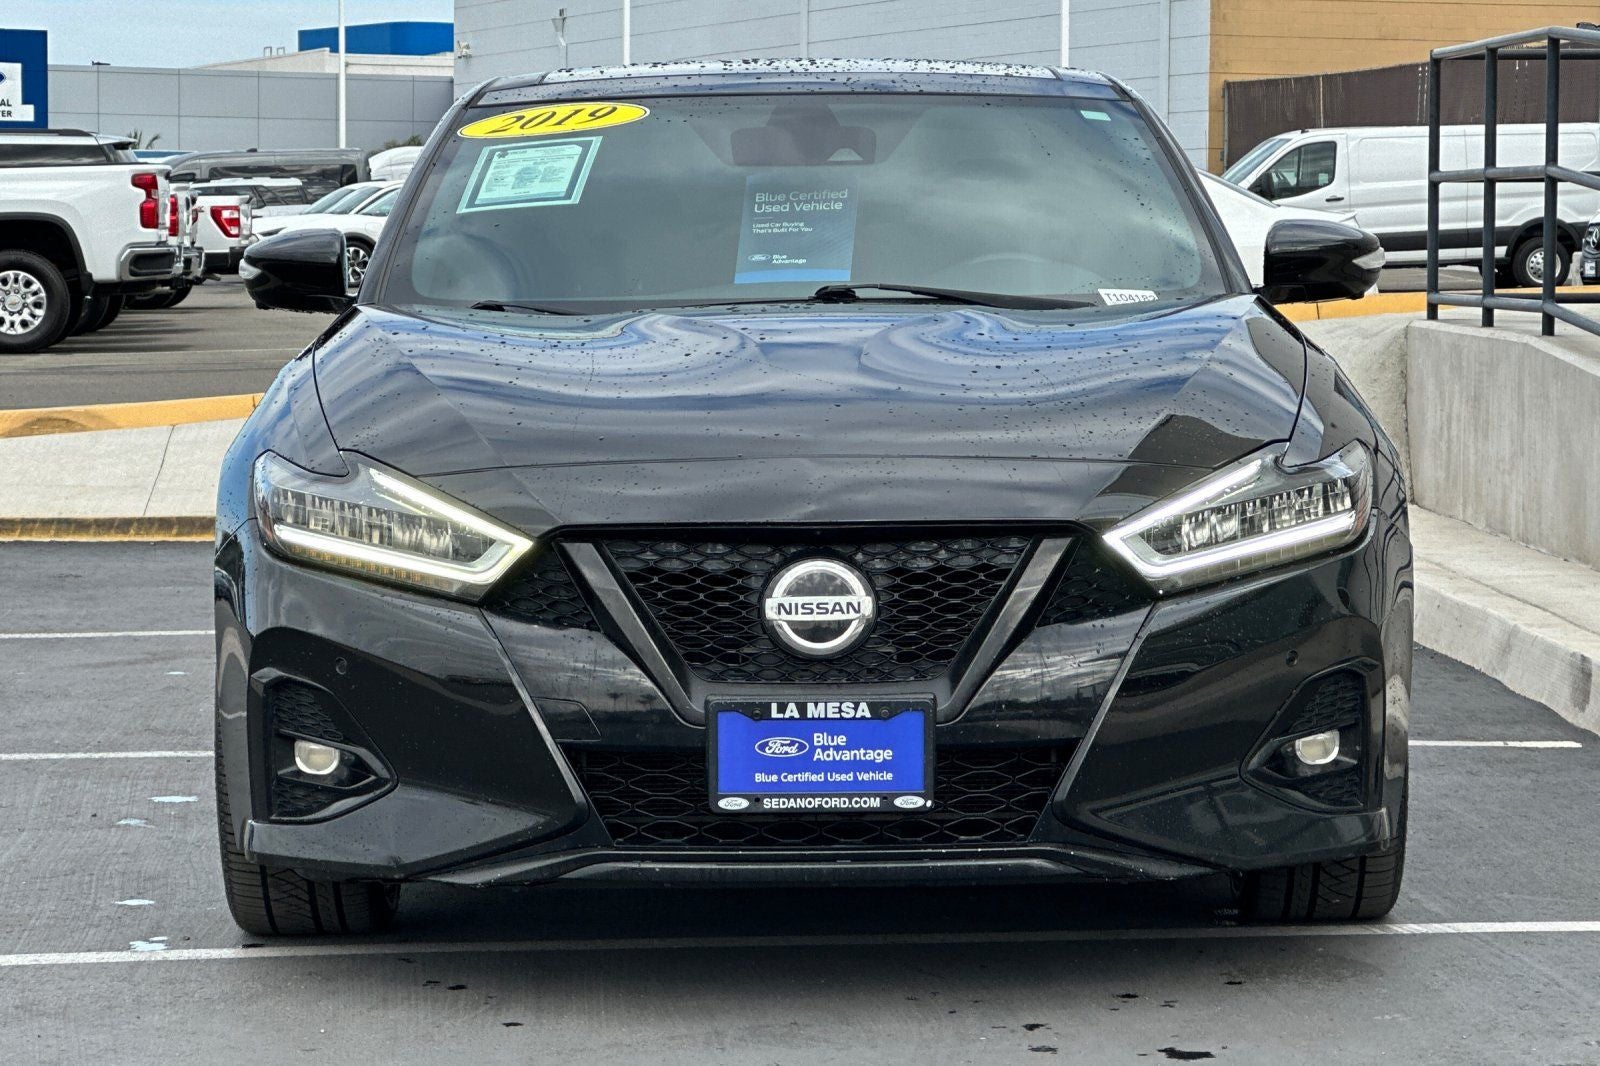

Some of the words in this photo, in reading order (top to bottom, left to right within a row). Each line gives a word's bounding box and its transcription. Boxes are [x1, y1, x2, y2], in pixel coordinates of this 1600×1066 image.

[484, 105, 618, 134] 2019
[755, 192, 786, 202] Blue
[789, 189, 848, 201] Certified
[754, 202, 790, 213] Used
[793, 201, 843, 211] Vehicle
[777, 602, 861, 615] NISSAN
[771, 703, 800, 719] LA
[807, 702, 872, 719] MESA
[813, 732, 847, 746] Blue
[765, 739, 799, 755] Ford
[813, 748, 893, 763] Advantage
[755, 773, 778, 783] Blue
[781, 772, 825, 782] Certified
[827, 772, 854, 782] Used
[856, 771, 893, 781] Vehicle
[763, 797, 881, 809] SEDANOFORD.COM
